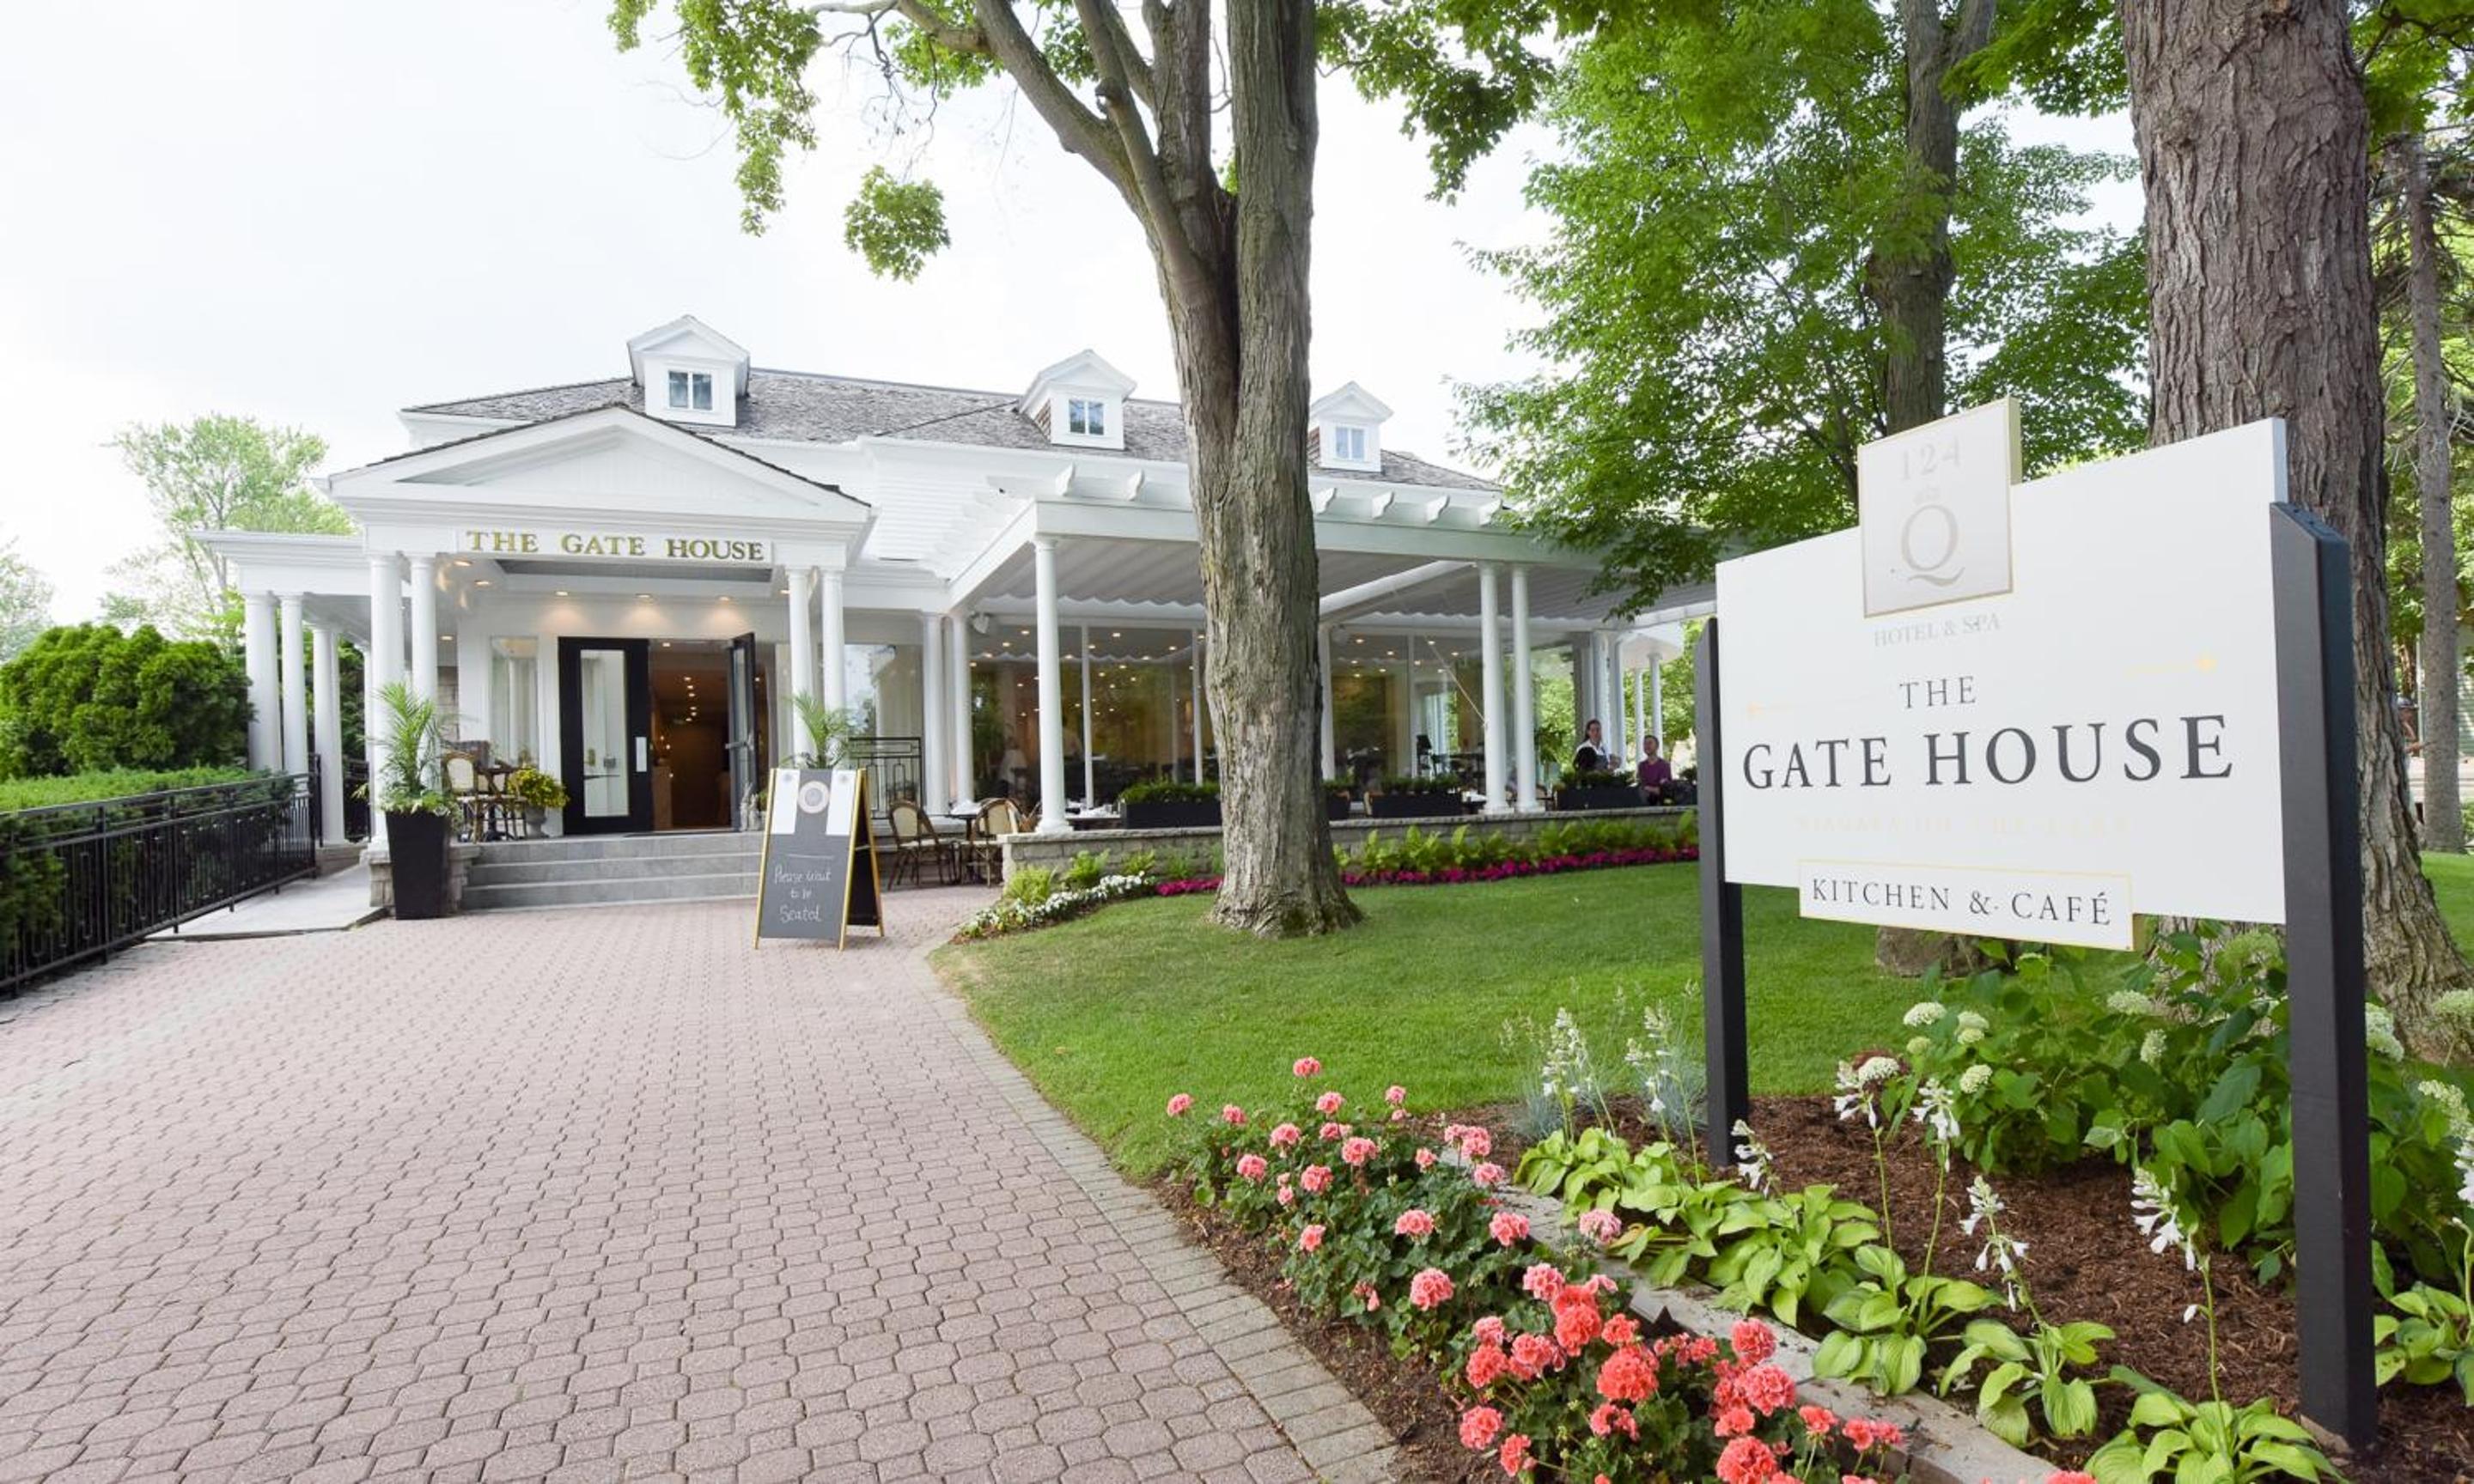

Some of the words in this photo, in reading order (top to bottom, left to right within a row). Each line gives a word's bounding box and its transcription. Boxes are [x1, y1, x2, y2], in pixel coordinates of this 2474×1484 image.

[1900, 435, 1960, 481] 124
[466, 531, 539, 553] THE
[560, 533, 645, 556] GATE
[667, 538, 765, 561] HOUSE
[1900, 504, 1965, 587] Q
[1874, 620, 1938, 648] HOTEL
[1944, 619, 1958, 636] &
[1963, 612, 2001, 634] SPA
[1898, 676, 1976, 709] THE
[1743, 736, 1892, 789] GATE
[1923, 714, 2233, 786] HOUSE
[1813, 878, 1950, 911] KITCHEN
[1969, 891, 1991, 916] &
[2011, 891, 2111, 926] CAFÉ
